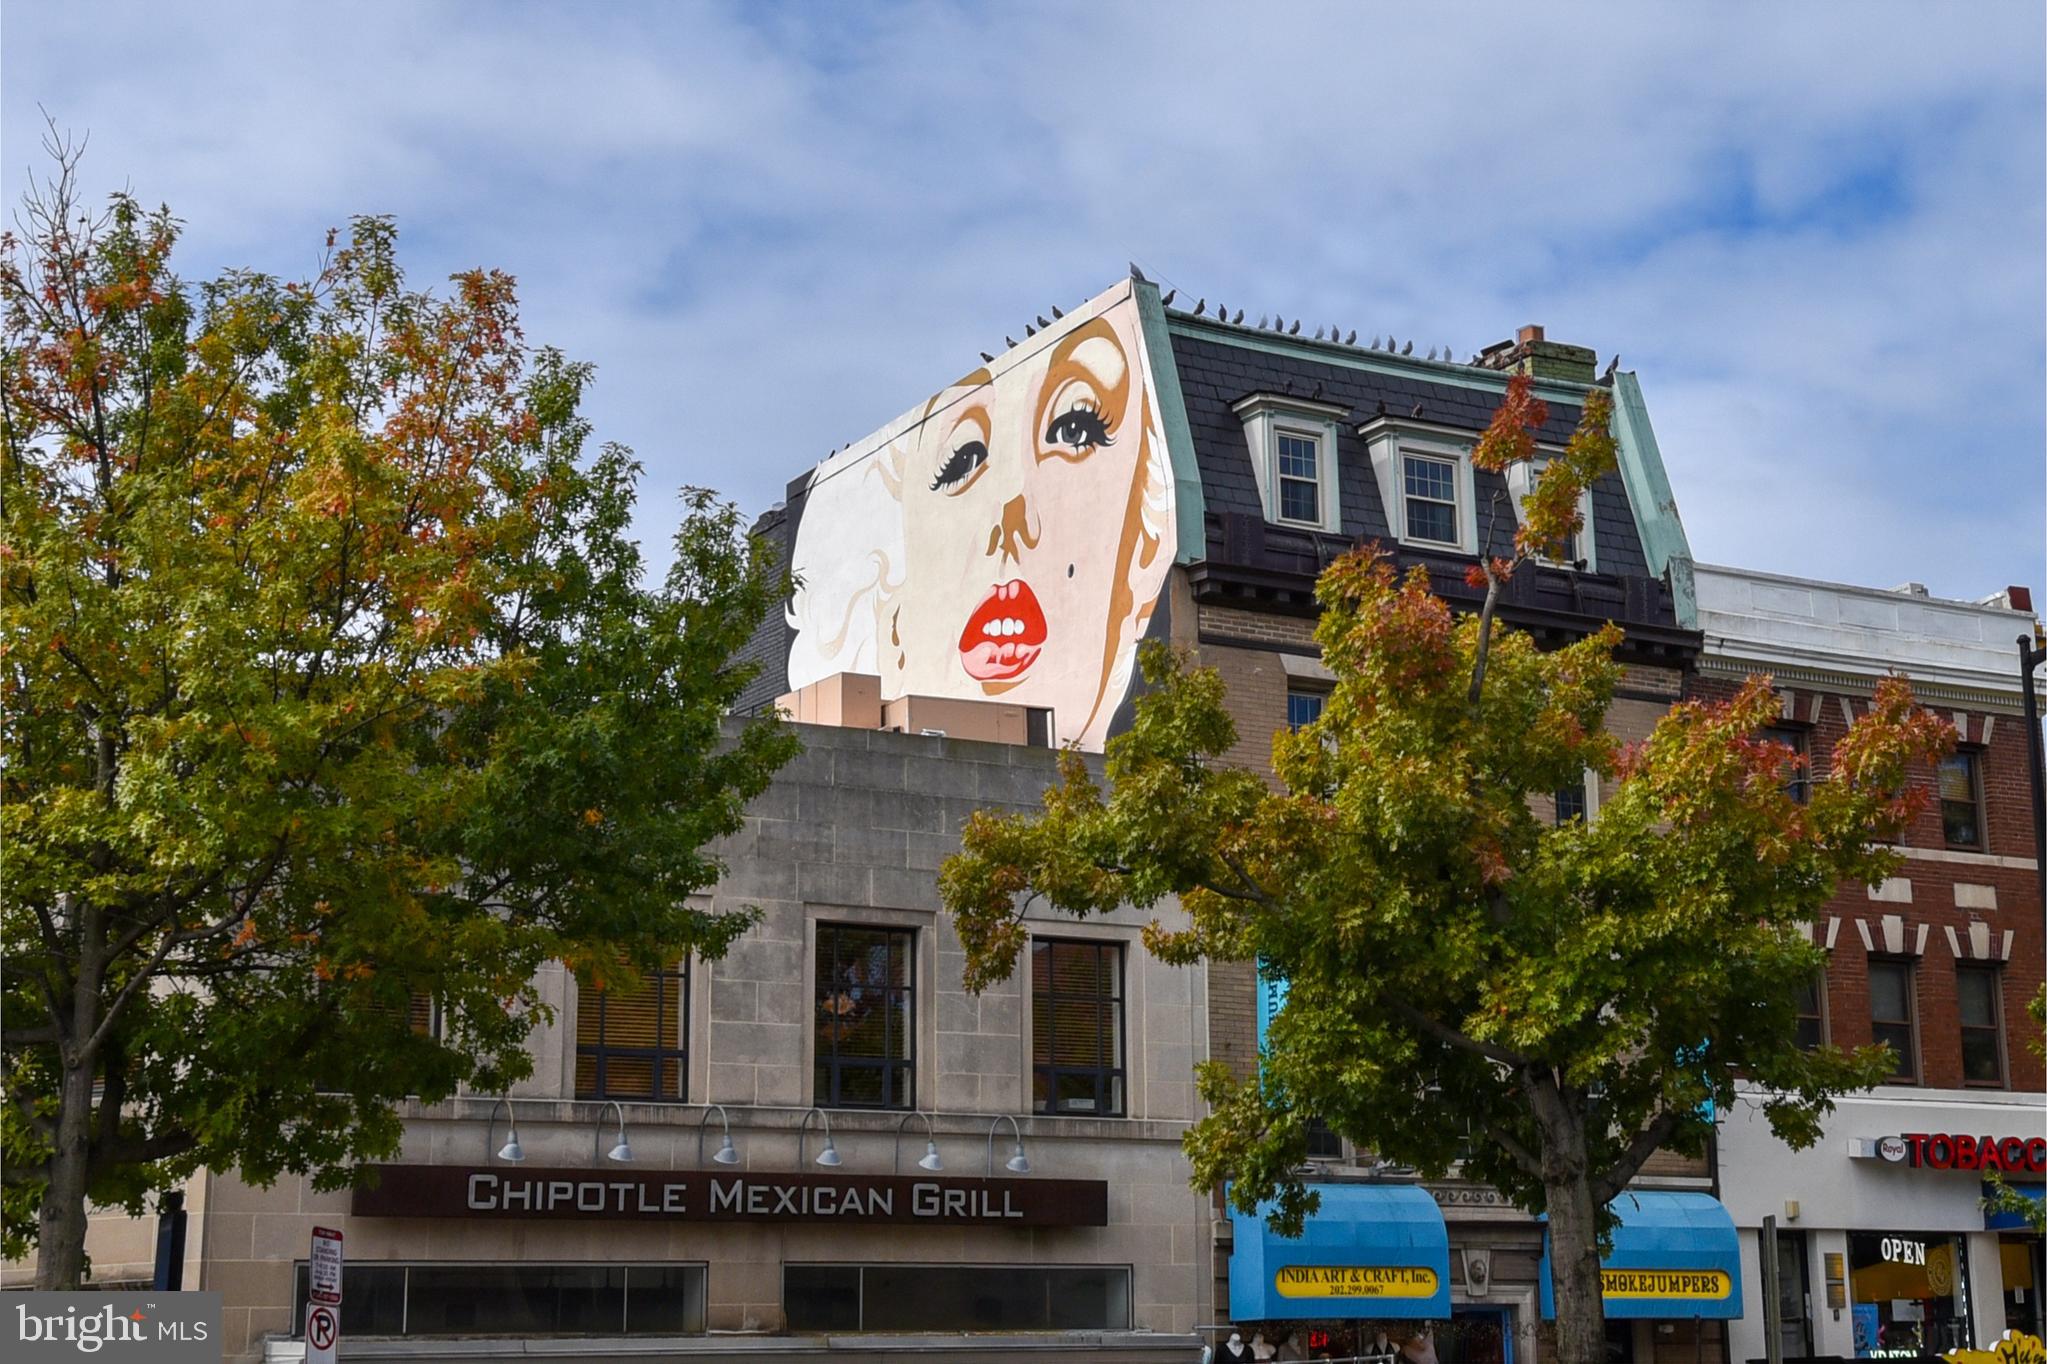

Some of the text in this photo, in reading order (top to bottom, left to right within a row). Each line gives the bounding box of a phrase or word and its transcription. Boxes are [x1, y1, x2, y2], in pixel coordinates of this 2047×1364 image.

[1882, 1143, 1904, 1156] Royal
[467, 1174, 1024, 1217] CHIPOTLE MEXICAN GRILL
[1881, 1238, 1926, 1266] OPEN
[1281, 1269, 1431, 1285] INDIA ART & CRAFT, Inc.
[1600, 1274, 1719, 1293] SMOKEJUMPERS
[1329, 1285, 1384, 1295] 202.299.0067
